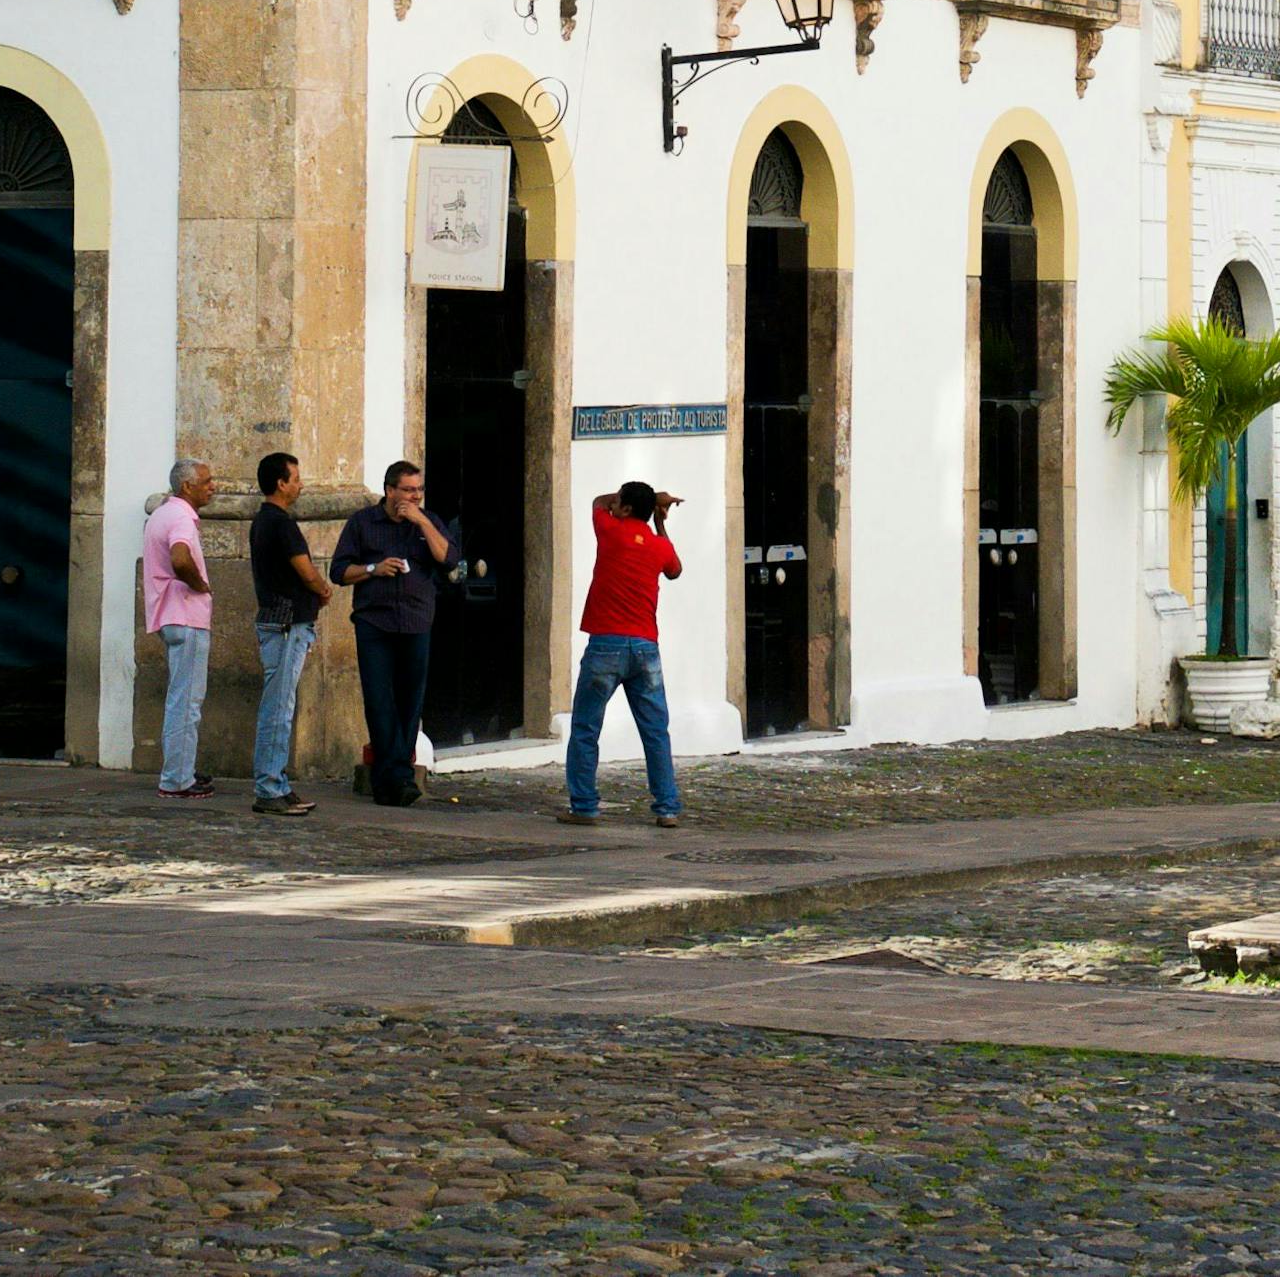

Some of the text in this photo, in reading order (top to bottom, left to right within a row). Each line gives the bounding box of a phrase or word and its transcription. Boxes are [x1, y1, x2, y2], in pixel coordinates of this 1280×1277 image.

[428, 273, 483, 282] POLICE STATION
[579, 411, 624, 432] DELEGACIA
[627, 412, 638, 430] DE
[641, 408, 681, 431] PROTEÇÃO
[697, 409, 727, 428] TURISTA
